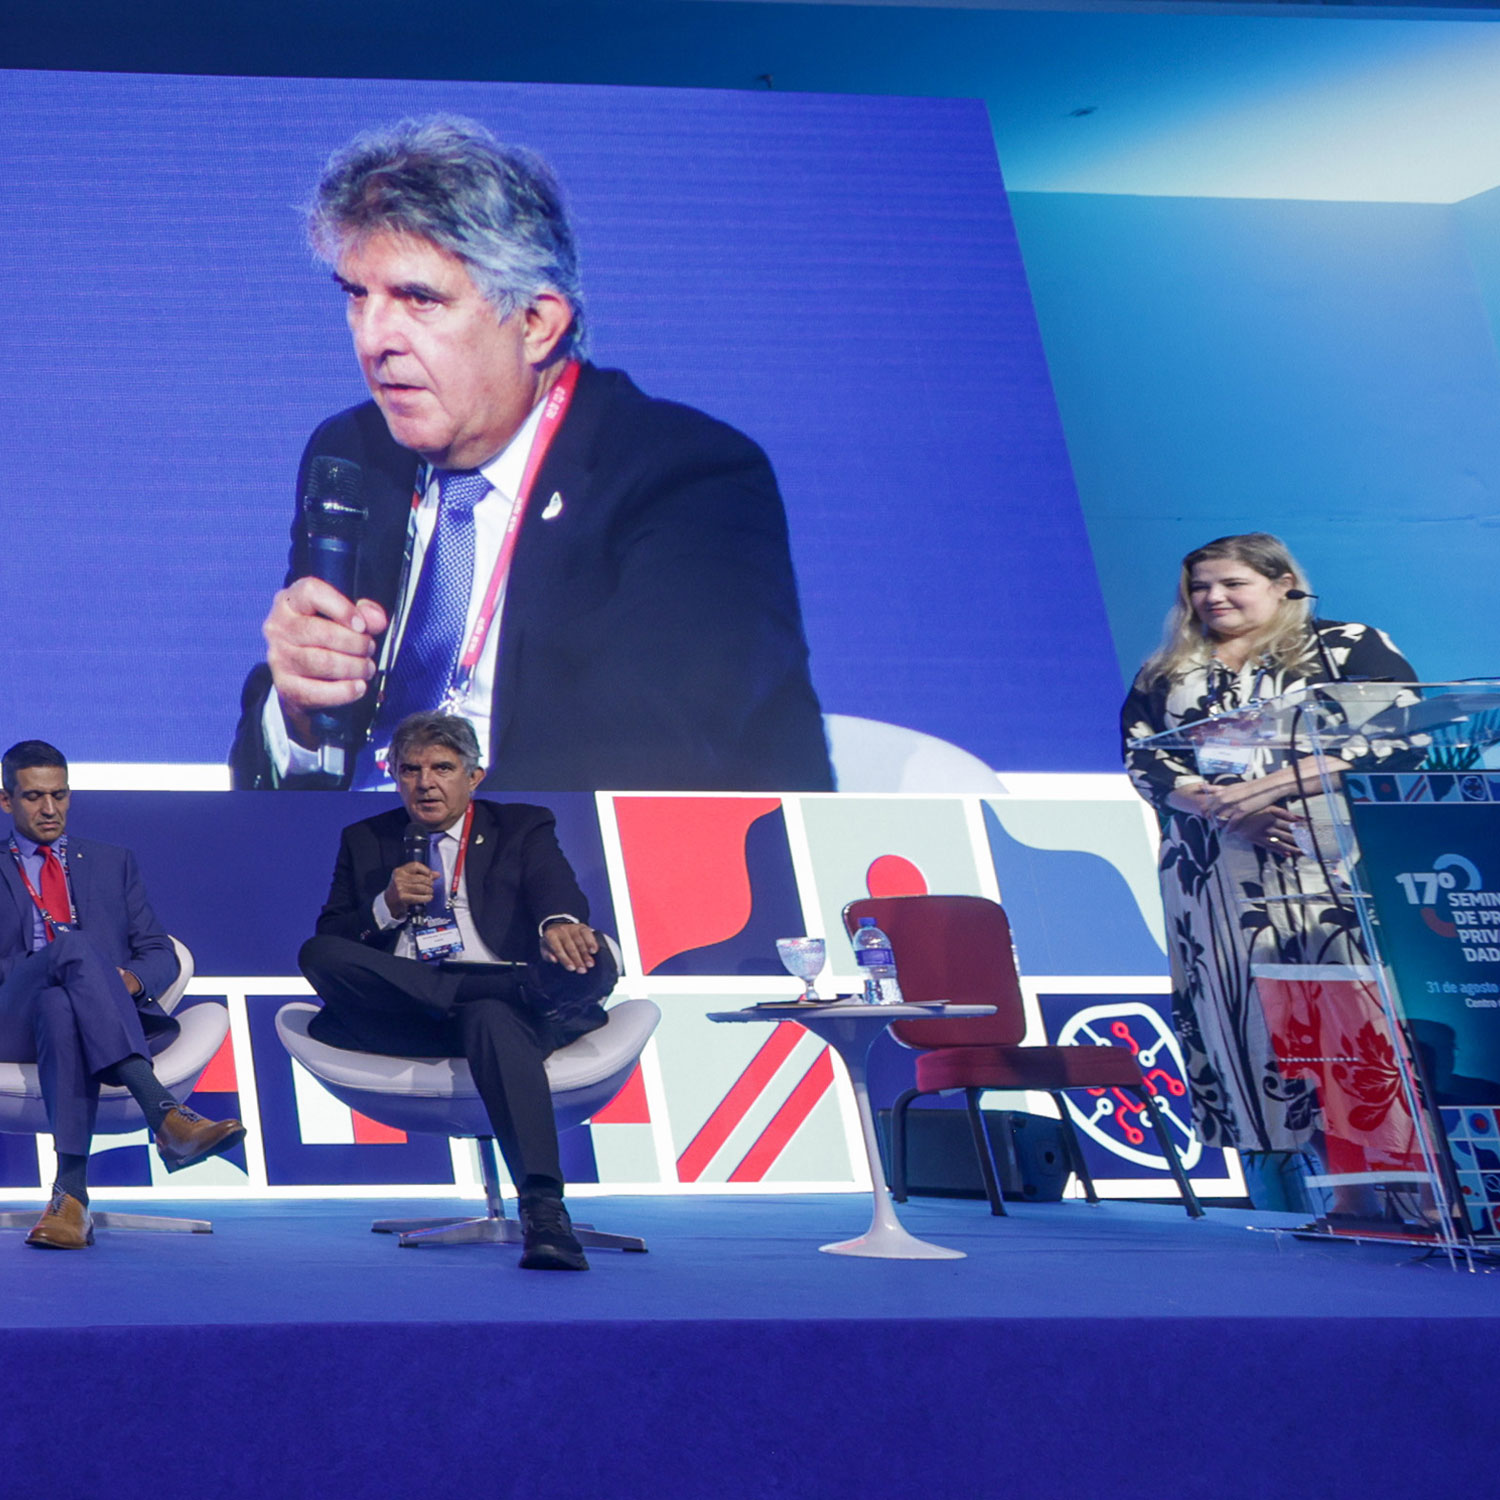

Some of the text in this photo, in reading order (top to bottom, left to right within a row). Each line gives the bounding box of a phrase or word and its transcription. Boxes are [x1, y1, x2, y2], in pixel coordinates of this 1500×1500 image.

[1451, 911, 1500, 925] DE PR
[1456, 929, 1499, 943] PRIV
[1461, 947, 1500, 962] DAD
[1425, 981, 1499, 996] 31 de agosto
